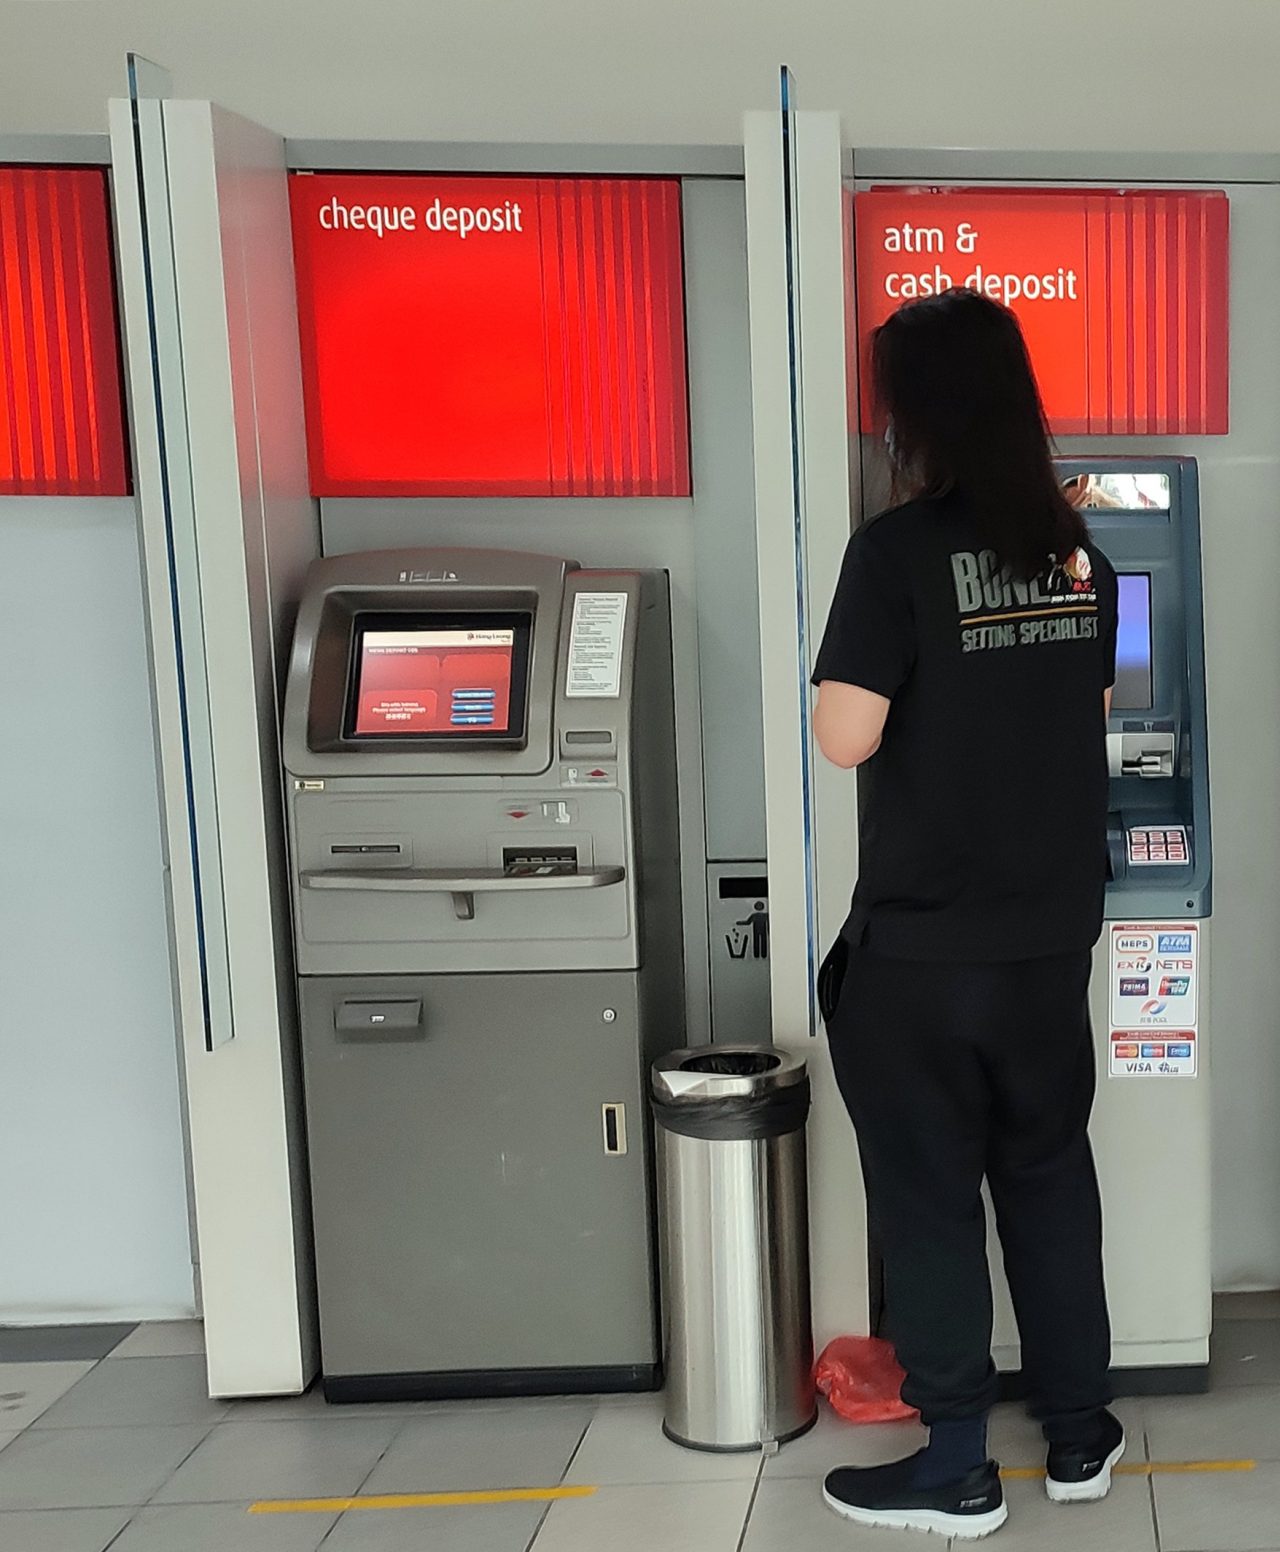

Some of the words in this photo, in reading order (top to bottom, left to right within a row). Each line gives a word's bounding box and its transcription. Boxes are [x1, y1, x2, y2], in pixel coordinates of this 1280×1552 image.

[319, 197, 415, 237] cheque
[426, 198, 522, 238] deposit
[884, 222, 943, 252] atm
[956, 223, 978, 253] &
[885, 265, 952, 298] cash
[965, 265, 1077, 307] deposit
[962, 625, 1016, 653] SETTING
[1020, 617, 1098, 645] SPECIALIST
[1121, 940, 1148, 948] MEPS
[1160, 935, 1190, 945] ATM
[1156, 960, 1193, 970] NETS
[1126, 1062, 1152, 1072] VISA
